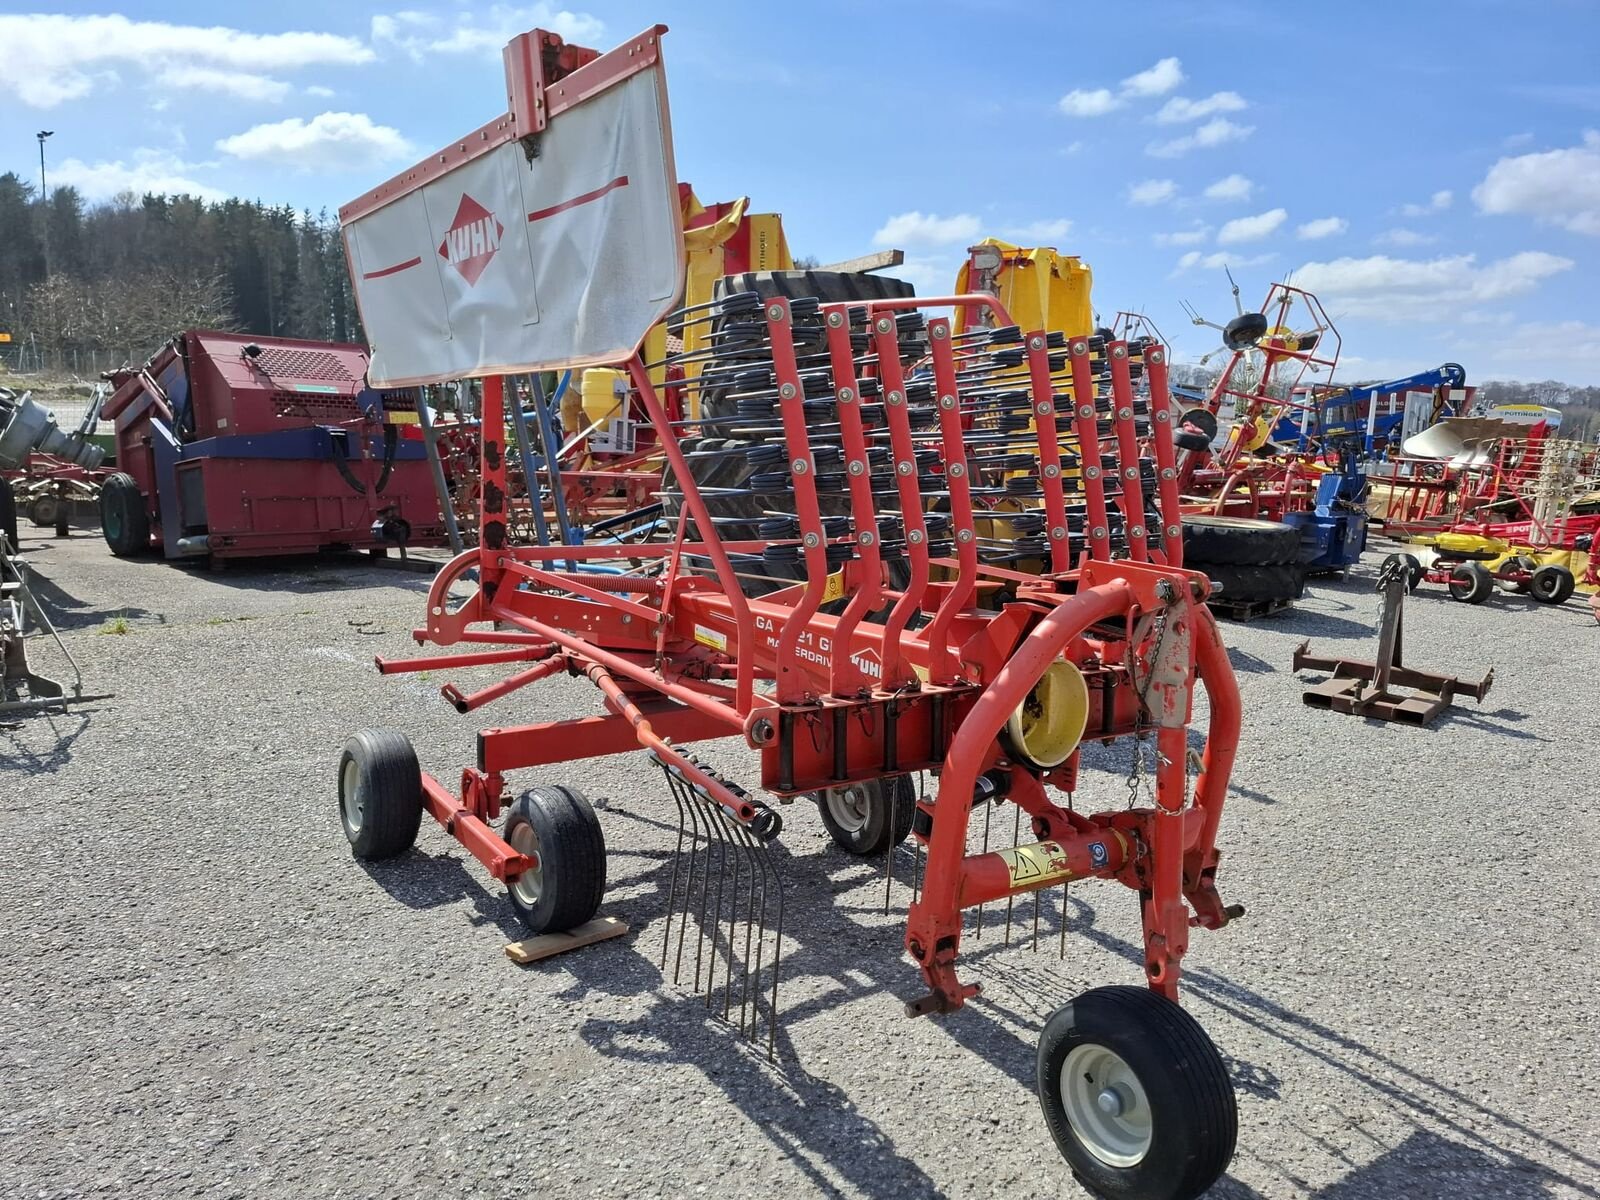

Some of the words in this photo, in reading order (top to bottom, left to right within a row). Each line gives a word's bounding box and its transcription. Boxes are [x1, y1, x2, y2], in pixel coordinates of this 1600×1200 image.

[445, 212, 500, 266] KUHN
[756, 616, 774, 632] GA
[819, 638, 833, 652] G
